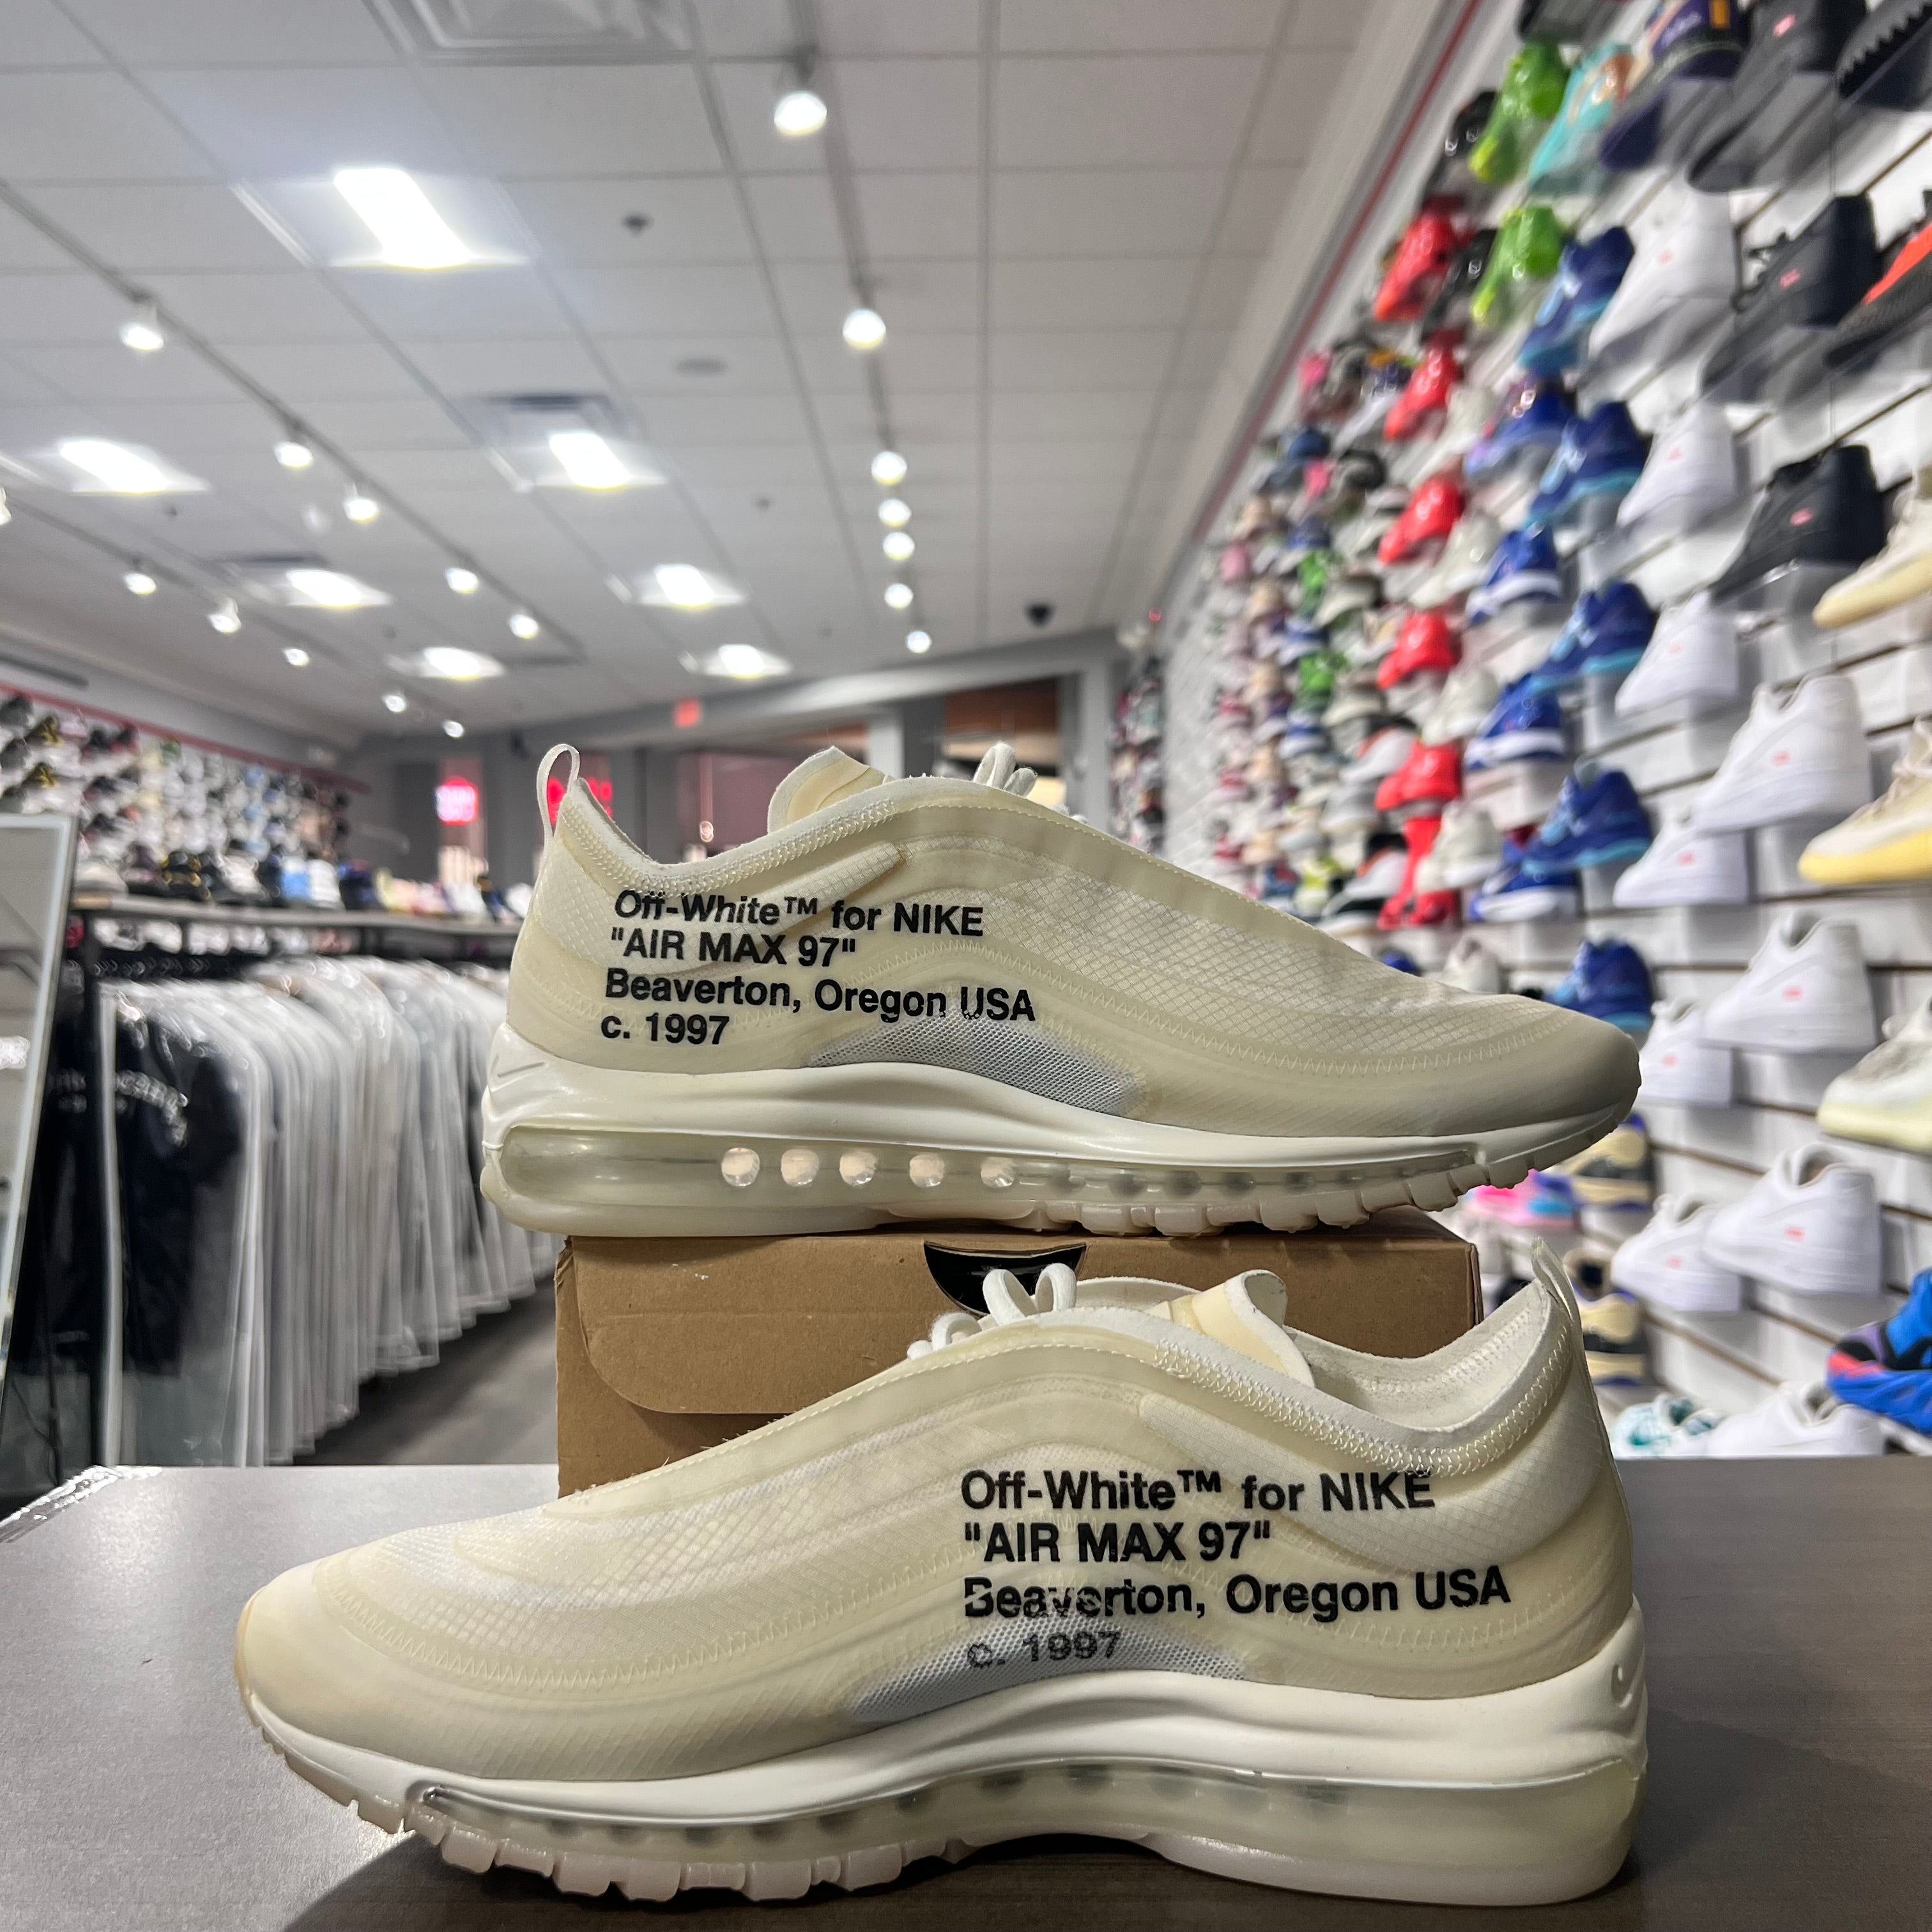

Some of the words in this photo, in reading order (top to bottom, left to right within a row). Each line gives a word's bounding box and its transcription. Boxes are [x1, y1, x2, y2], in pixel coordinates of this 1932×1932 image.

[831, 900, 882, 931] for
[894, 903, 984, 937] NIKE
[611, 926, 685, 960] "AIR
[698, 932, 787, 965] MAX
[797, 937, 857, 968] 97"
[606, 967, 802, 1013] Beaverton,
[815, 979, 947, 1023] Oregon
[960, 986, 1036, 1022] USA
[601, 1018, 631, 1040] c.
[645, 1012, 730, 1045] 1997
[1241, 1475, 1306, 1512] for
[1320, 1470, 1436, 1510] NIKE
[965, 1521, 1061, 1563] "AIR
[1078, 1522, 1186, 1562] MAX
[1198, 1520, 1271, 1561] 97"
[965, 1577, 1206, 1619] Beaverton,
[1226, 1573, 1399, 1623] Oregon
[1414, 1565, 1511, 1611] USA
[966, 1643, 1006, 1669] c.
[1022, 1630, 1121, 1662] 1997
